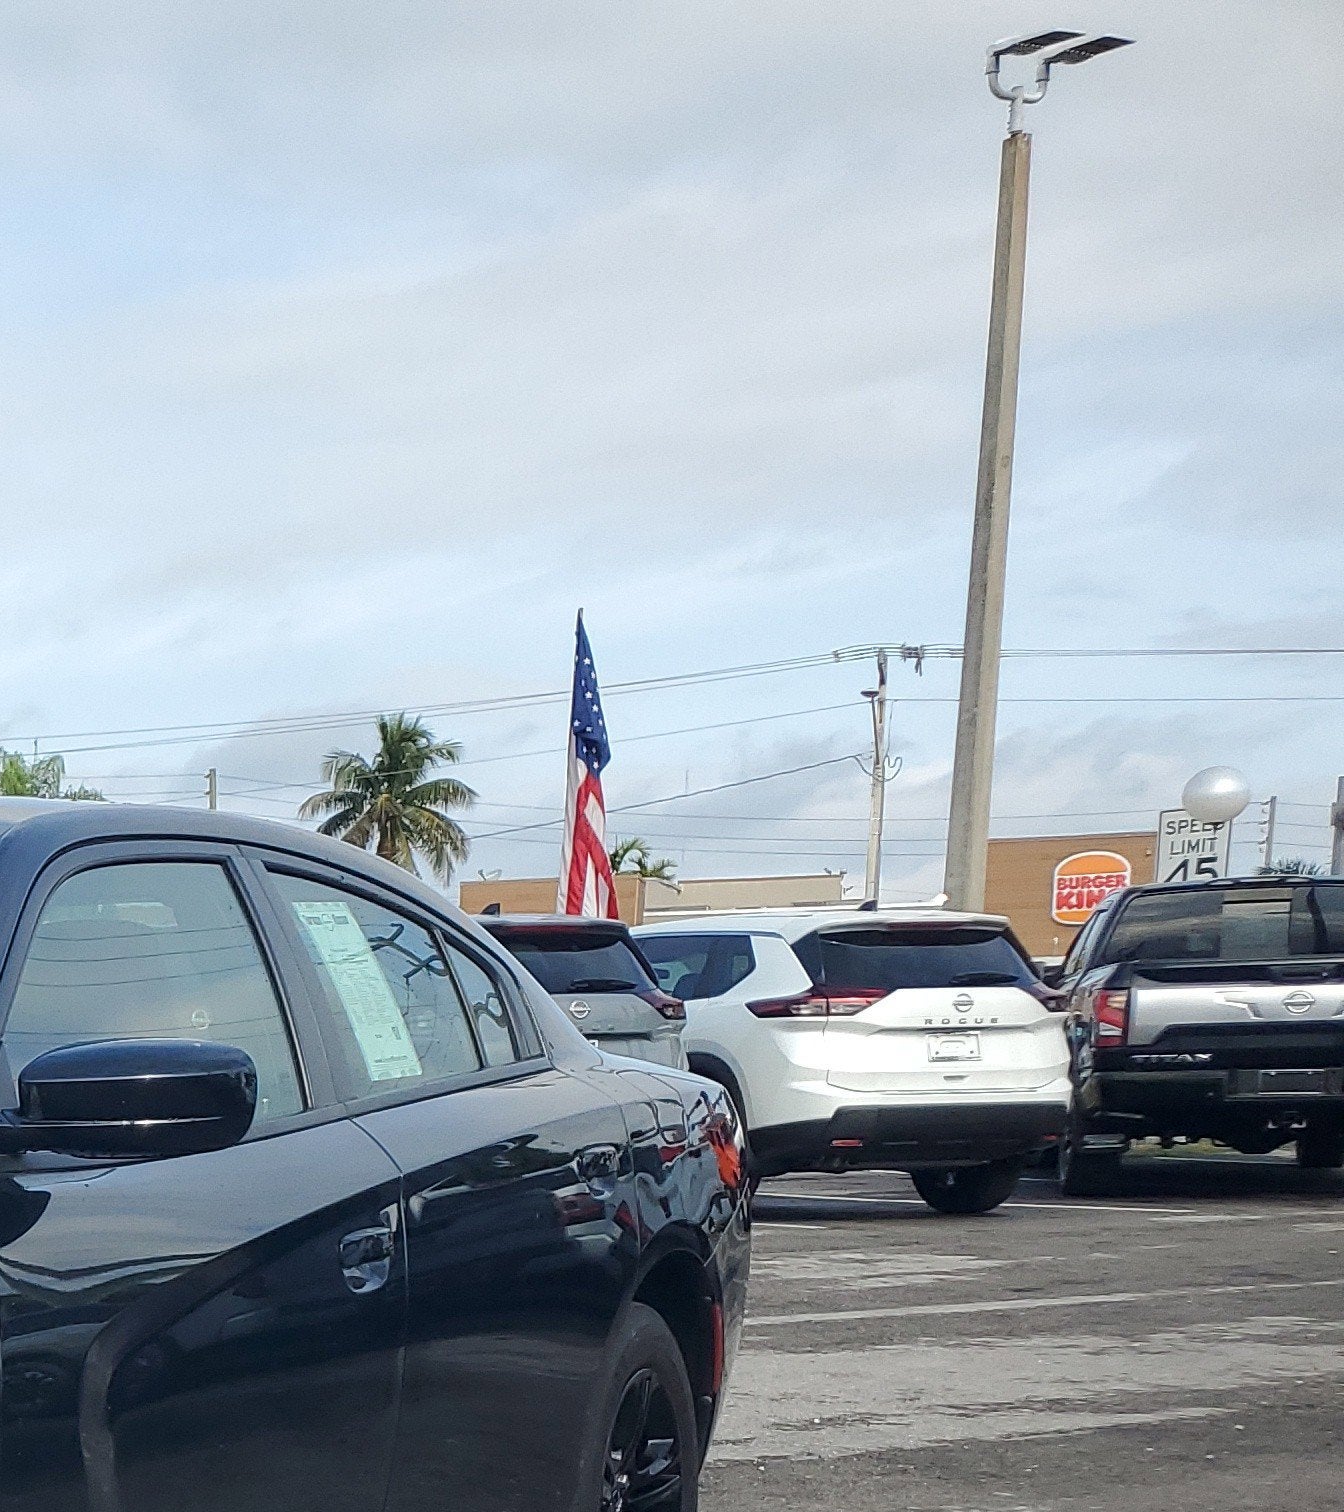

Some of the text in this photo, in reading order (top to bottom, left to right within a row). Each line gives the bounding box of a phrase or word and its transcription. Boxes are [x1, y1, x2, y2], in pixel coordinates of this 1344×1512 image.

[1170, 837, 1219, 855] LIMIT
[1057, 874, 1128, 890] BURGER
[1056, 889, 1109, 910] KIN
[924, 1017, 1000, 1025] ROGUE
